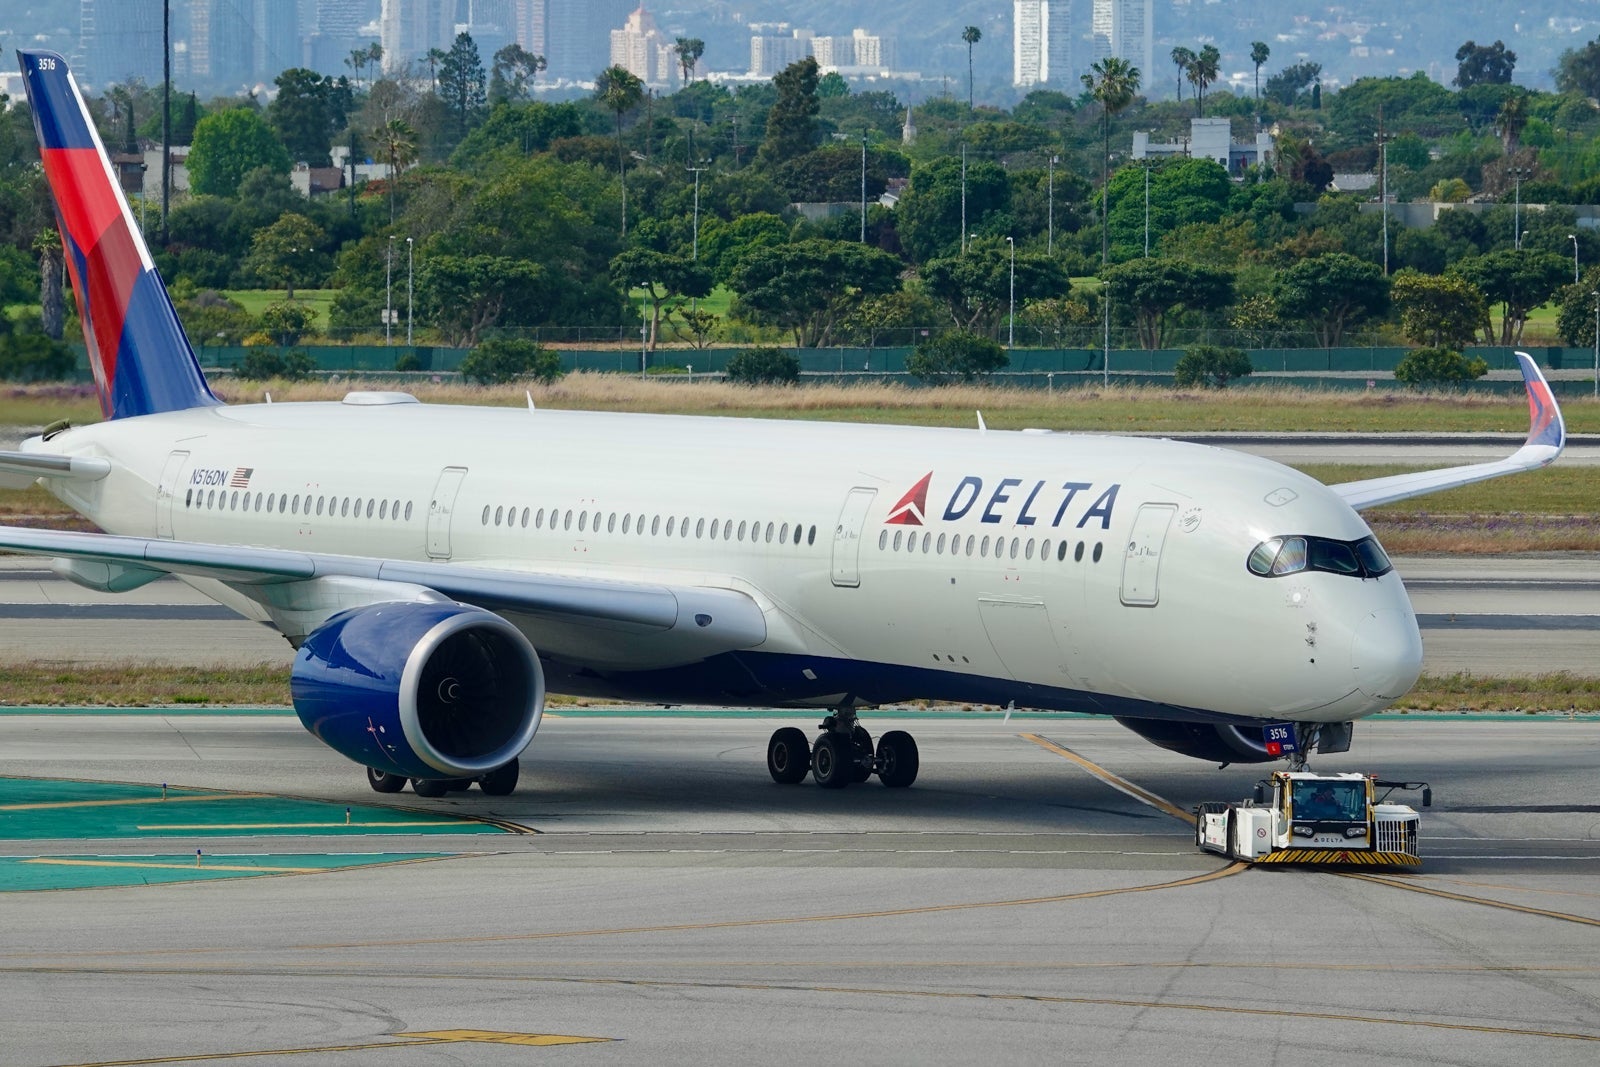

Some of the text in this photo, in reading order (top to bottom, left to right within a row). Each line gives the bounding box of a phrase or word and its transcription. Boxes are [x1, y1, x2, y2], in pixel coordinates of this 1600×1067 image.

[38, 58, 56, 70] 3516
[189, 468, 229, 486] N516DN
[942, 476, 1121, 529] DELTA
[1269, 728, 1288, 740] 3516
